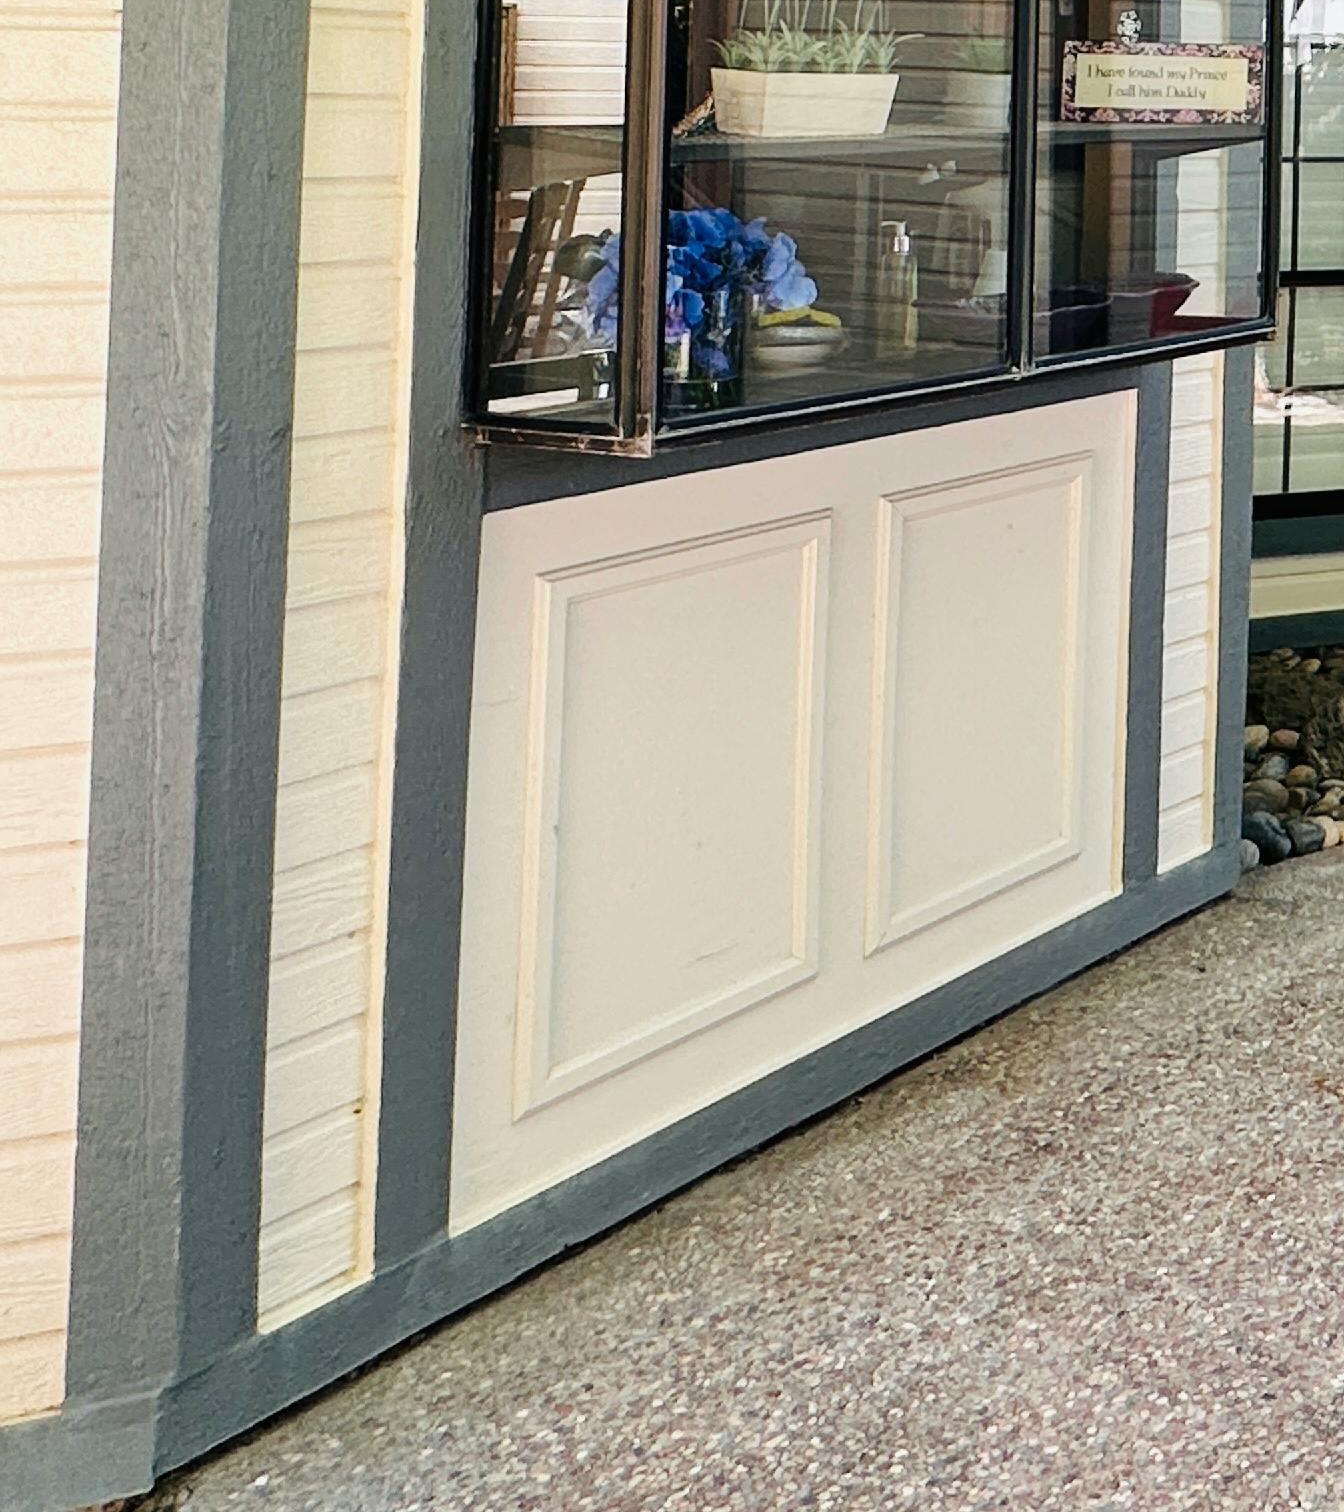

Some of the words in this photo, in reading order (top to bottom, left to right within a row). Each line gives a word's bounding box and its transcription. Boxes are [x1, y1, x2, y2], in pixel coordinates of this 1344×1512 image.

[1087, 64, 1092, 78] I
[1094, 64, 1126, 79] have
[1128, 64, 1164, 79] found
[1189, 66, 1228, 81] Prince
[1107, 84, 1113, 98] I
[1115, 84, 1136, 98] call
[1139, 84, 1163, 98] him
[1166, 84, 1207, 100] Daddy
